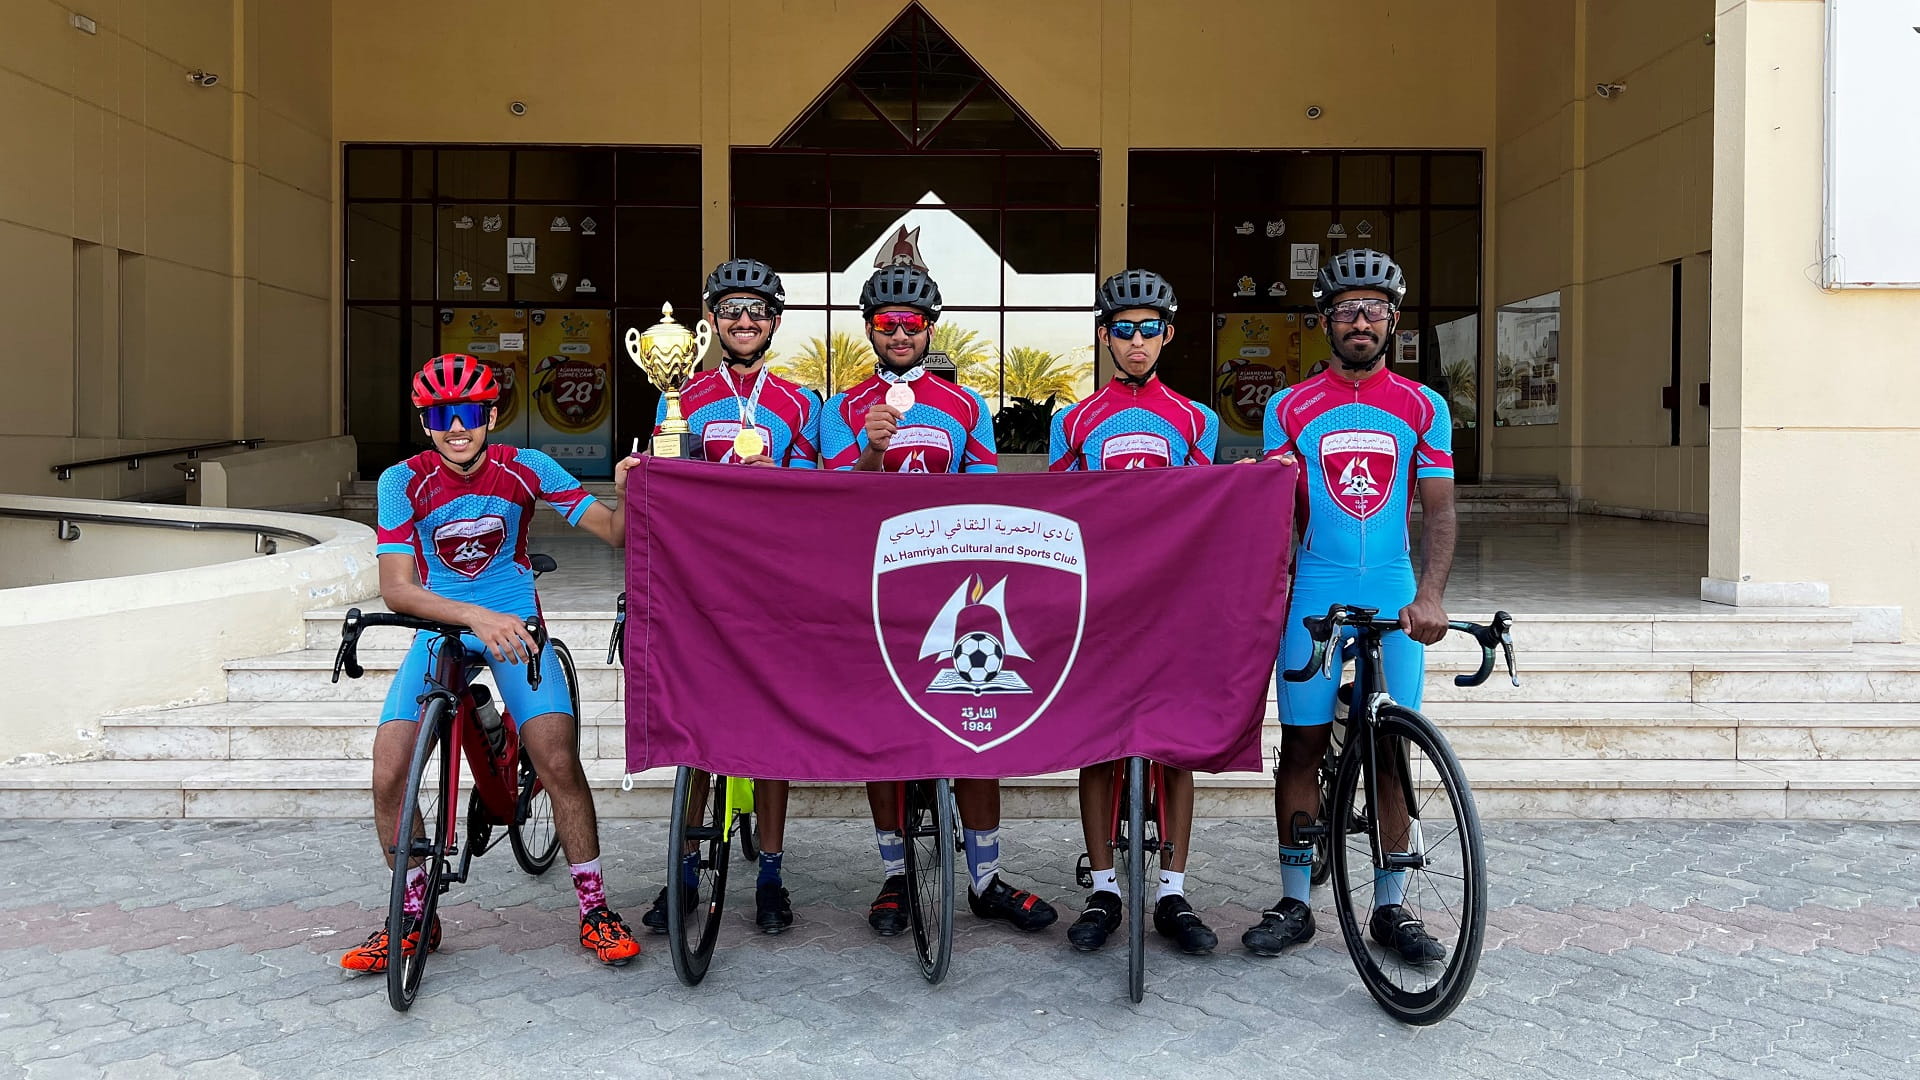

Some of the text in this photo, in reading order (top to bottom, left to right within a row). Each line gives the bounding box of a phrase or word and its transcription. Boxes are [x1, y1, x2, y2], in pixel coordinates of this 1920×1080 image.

[556, 380, 593, 404] 28
[1236, 384, 1273, 406] 28
[889, 517, 1074, 545] نادي الحمرية الثقافي الرياضي
[882, 543, 1078, 566] AL Hamriyah Cultural and Sports Club
[961, 706, 997, 721] الشارقة
[961, 720, 993, 732] 1984
